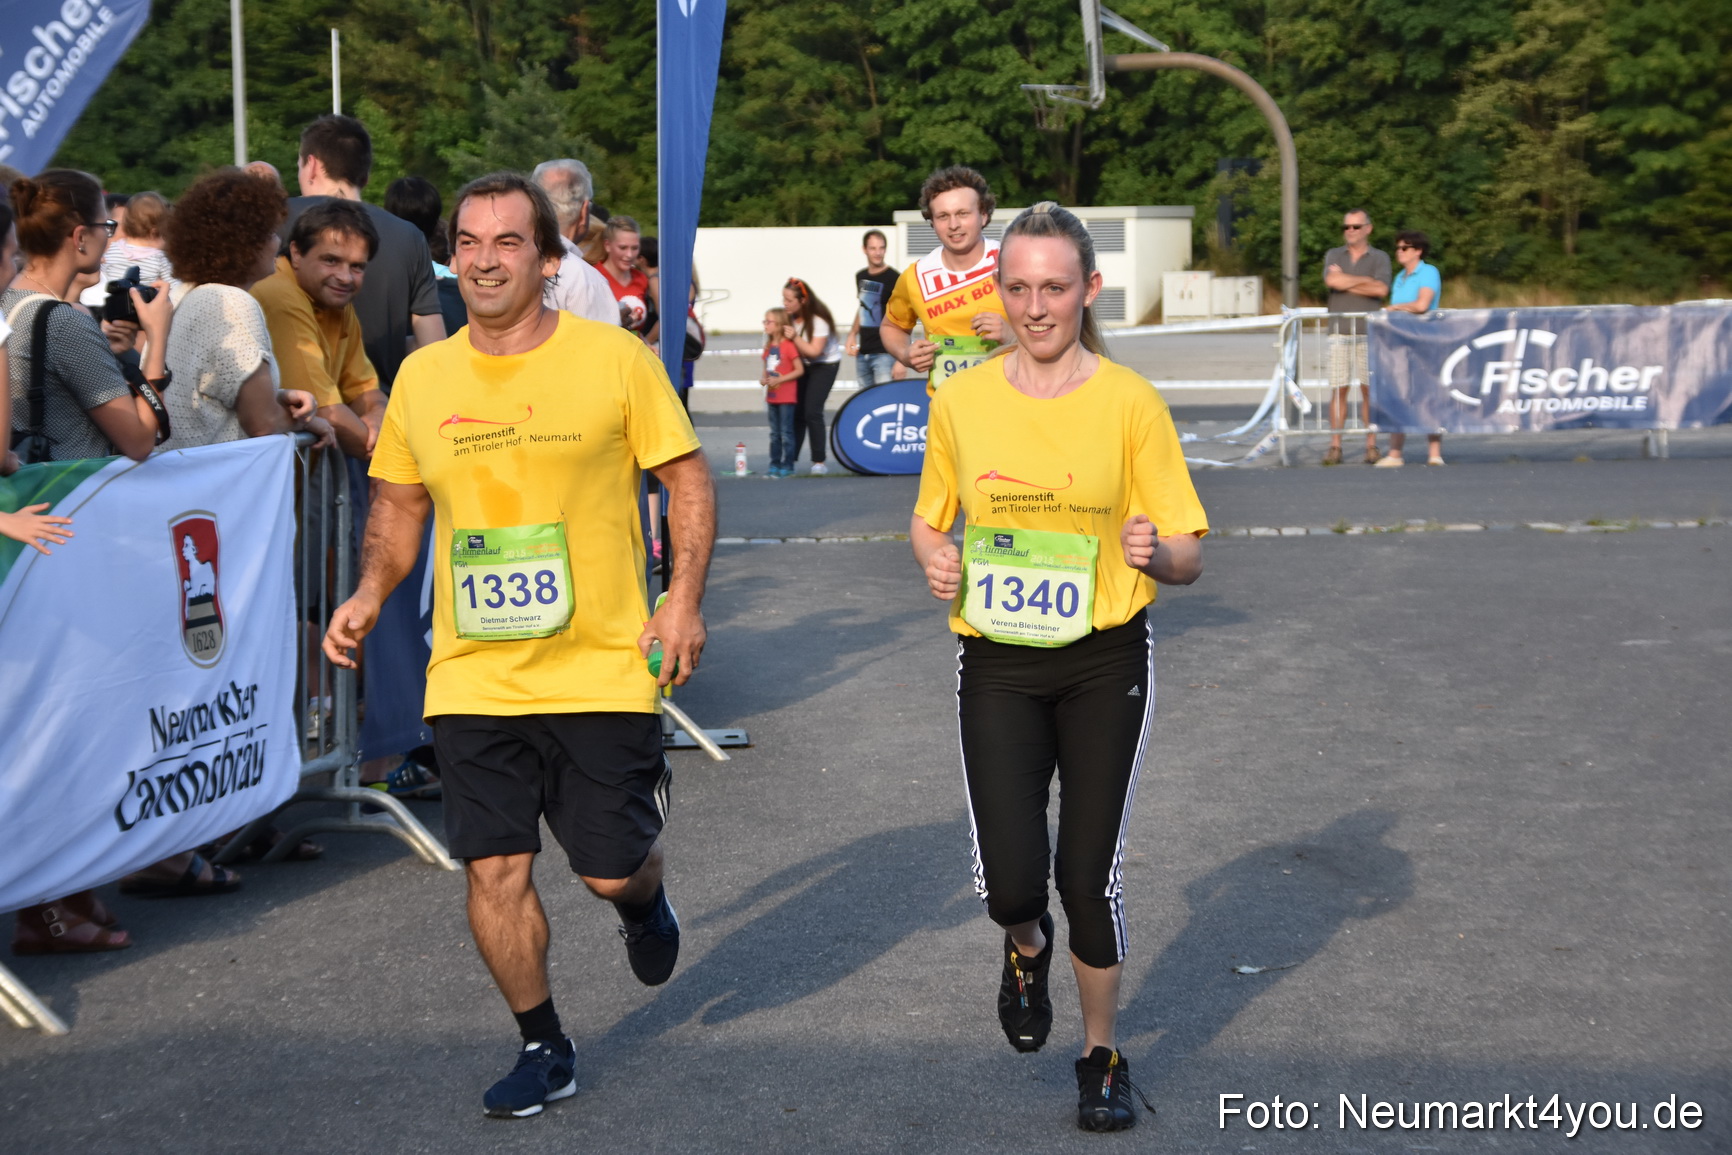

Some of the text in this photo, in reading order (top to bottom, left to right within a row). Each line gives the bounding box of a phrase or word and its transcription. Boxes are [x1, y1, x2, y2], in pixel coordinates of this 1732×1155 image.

[21, 5, 116, 139] AUTOMOBILE
[926, 294, 968, 319] MAX
[1480, 358, 1664, 396] Fischer
[139, 383, 162, 411] SONY
[1497, 396, 1648, 414] AUTOMOBILE
[453, 426, 516, 446] Seniorenstift
[453, 432, 582, 457] am Tiroler Hof Neumarkt
[891, 442, 926, 454] AUTO
[990, 492, 1055, 503] Seniorenstift
[991, 502, 1112, 515] am Tiroler Hof Neumarkt
[462, 546, 502, 556] firmenlauf
[985, 545, 1030, 558] firmenlauf
[461, 569, 559, 609] 1338
[977, 573, 1080, 618] 1340
[480, 615, 542, 624] Dietmar Schwarz
[990, 618, 1061, 632] Verena Bleisteiner
[191, 628, 217, 653] 1628
[148, 679, 259, 754] Neumarkter
